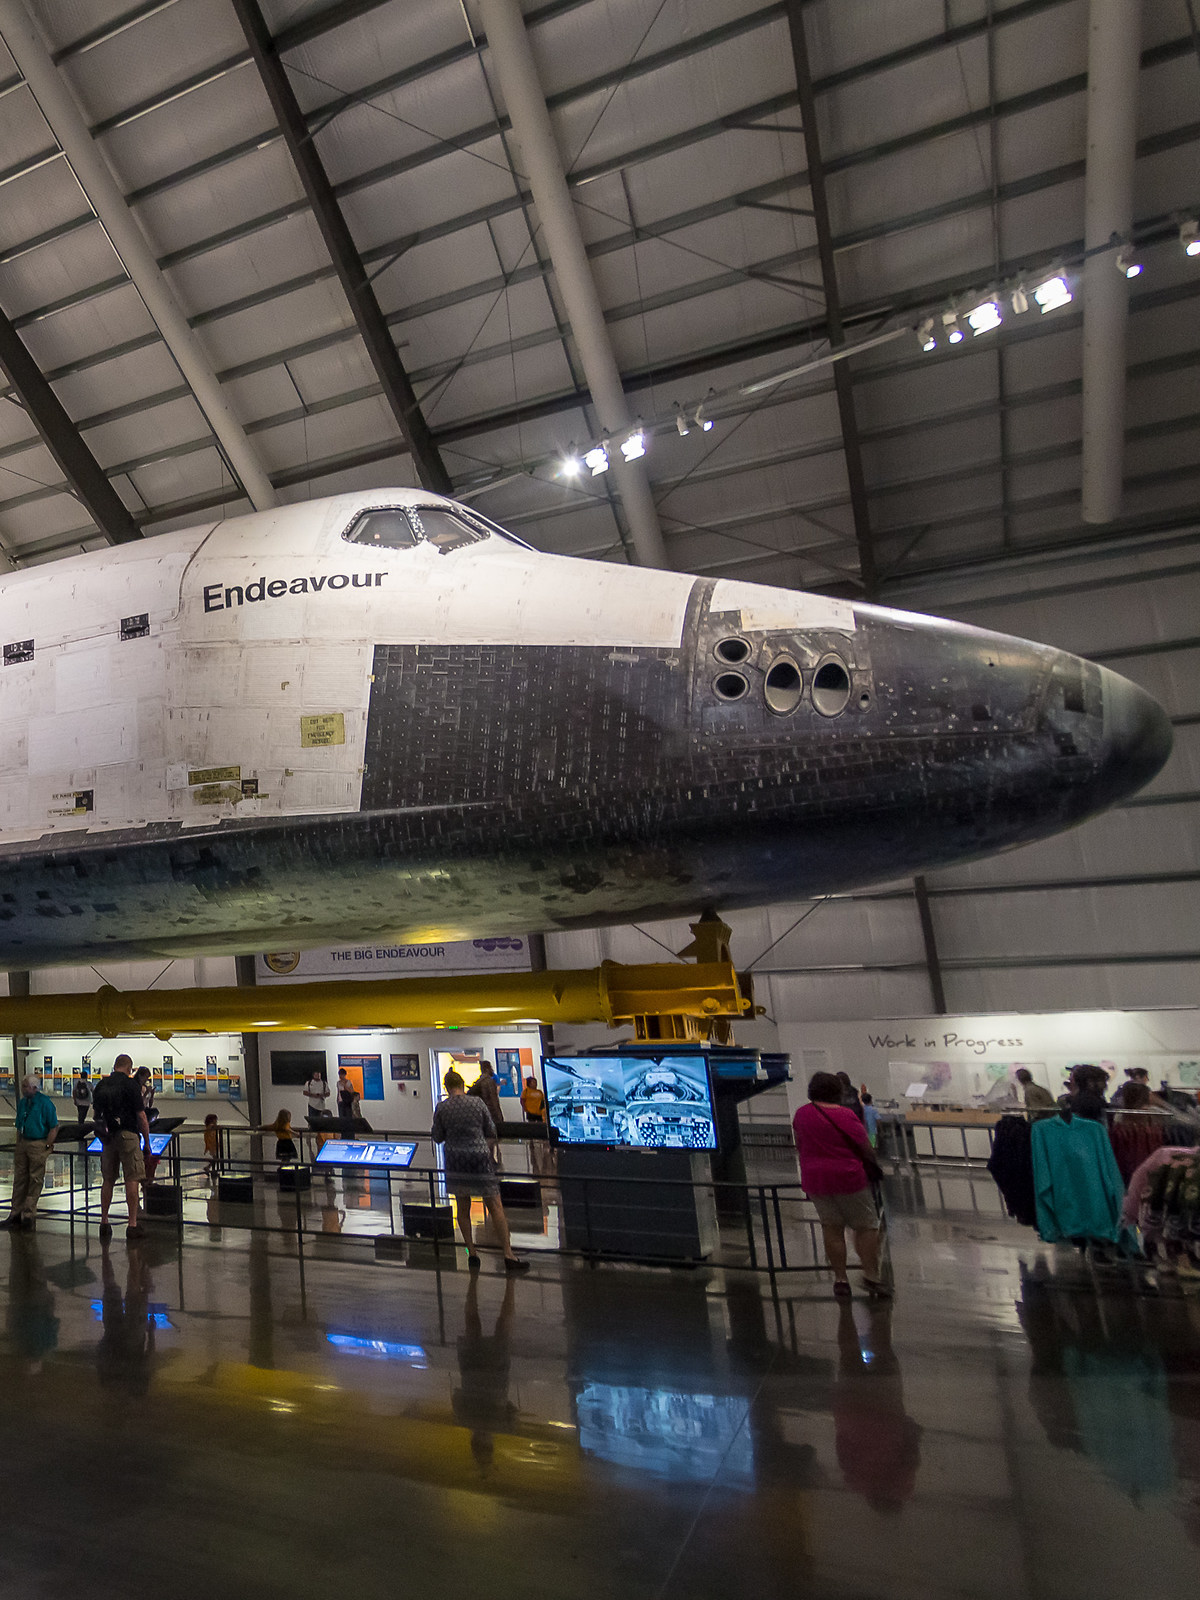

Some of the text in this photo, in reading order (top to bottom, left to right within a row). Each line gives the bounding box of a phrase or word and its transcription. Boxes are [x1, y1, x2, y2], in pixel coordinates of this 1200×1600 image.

[203, 572, 389, 613] Endeavour
[330, 946, 445, 962] THE BIG ENDEAVOUR
[868, 1032, 1023, 1054] Work in Progress
